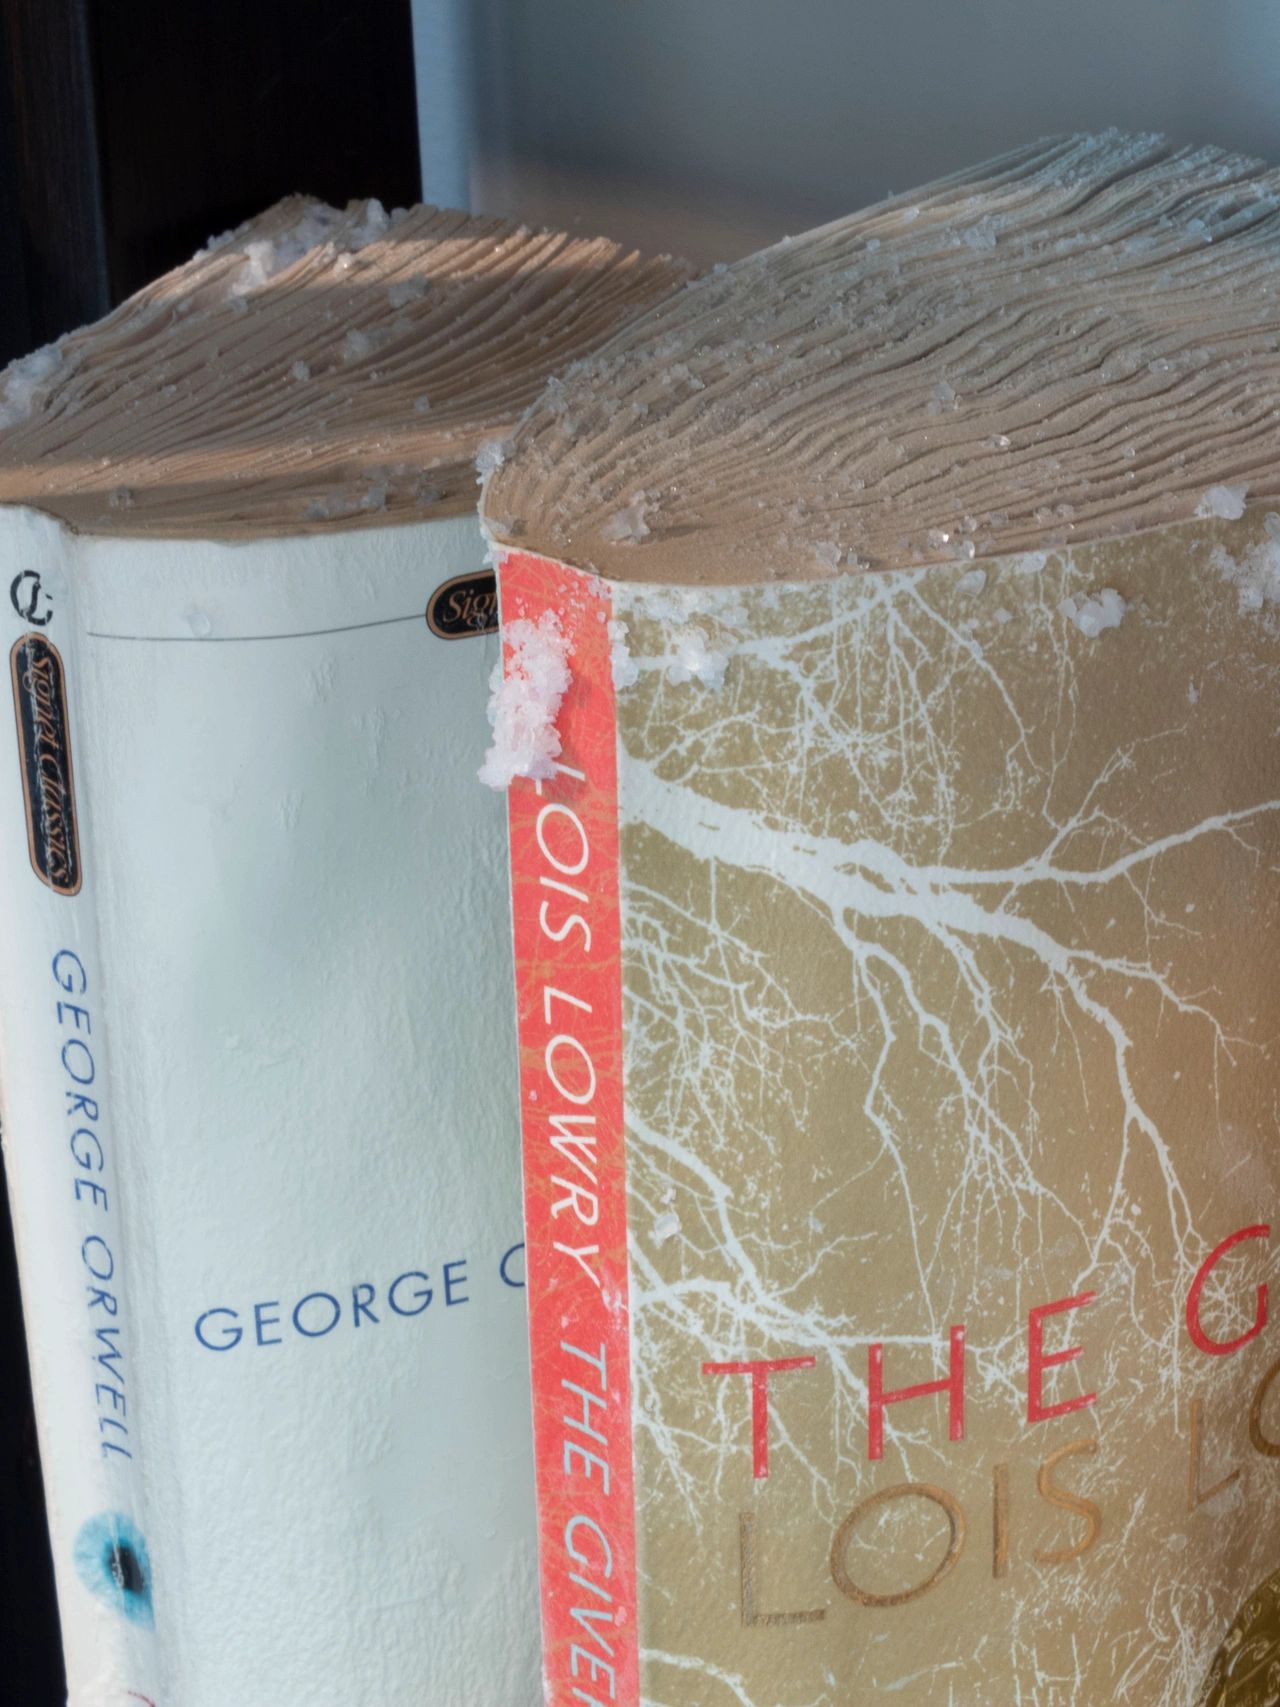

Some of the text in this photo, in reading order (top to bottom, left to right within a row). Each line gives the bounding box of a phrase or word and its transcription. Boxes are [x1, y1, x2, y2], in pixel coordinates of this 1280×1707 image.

[51, 948, 132, 1460] GEORGE ORWELL
[544, 985, 604, 1289] LOWRY
[194, 1259, 470, 1353] GEORGE
[701, 1291, 1098, 1478] THE
[560, 1340, 616, 1707] THE GIVE
[740, 1437, 1098, 1627] LOIS
